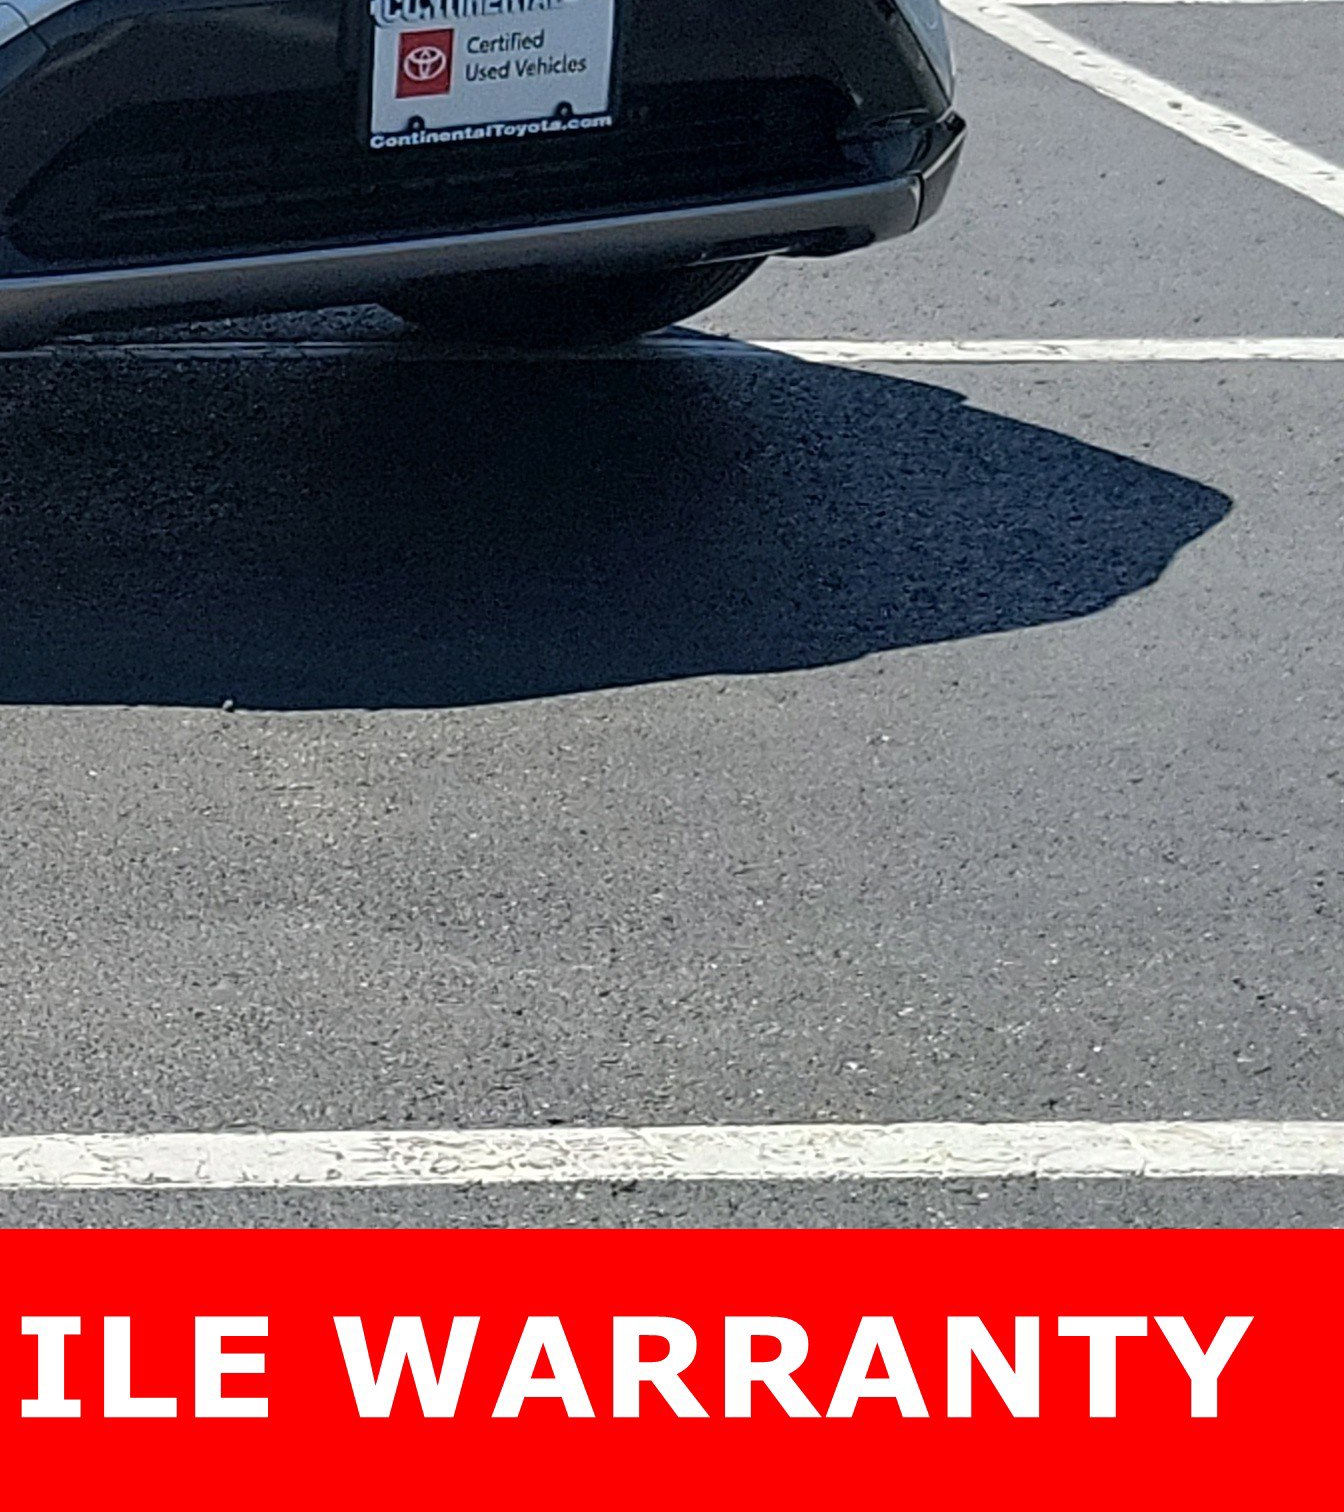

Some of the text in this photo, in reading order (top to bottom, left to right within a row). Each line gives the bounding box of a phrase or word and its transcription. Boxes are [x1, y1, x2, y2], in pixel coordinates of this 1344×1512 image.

[467, 29, 544, 54] Certified
[465, 54, 587, 82] Used Vehicles
[370, 115, 612, 149] ContinentalToyota.com
